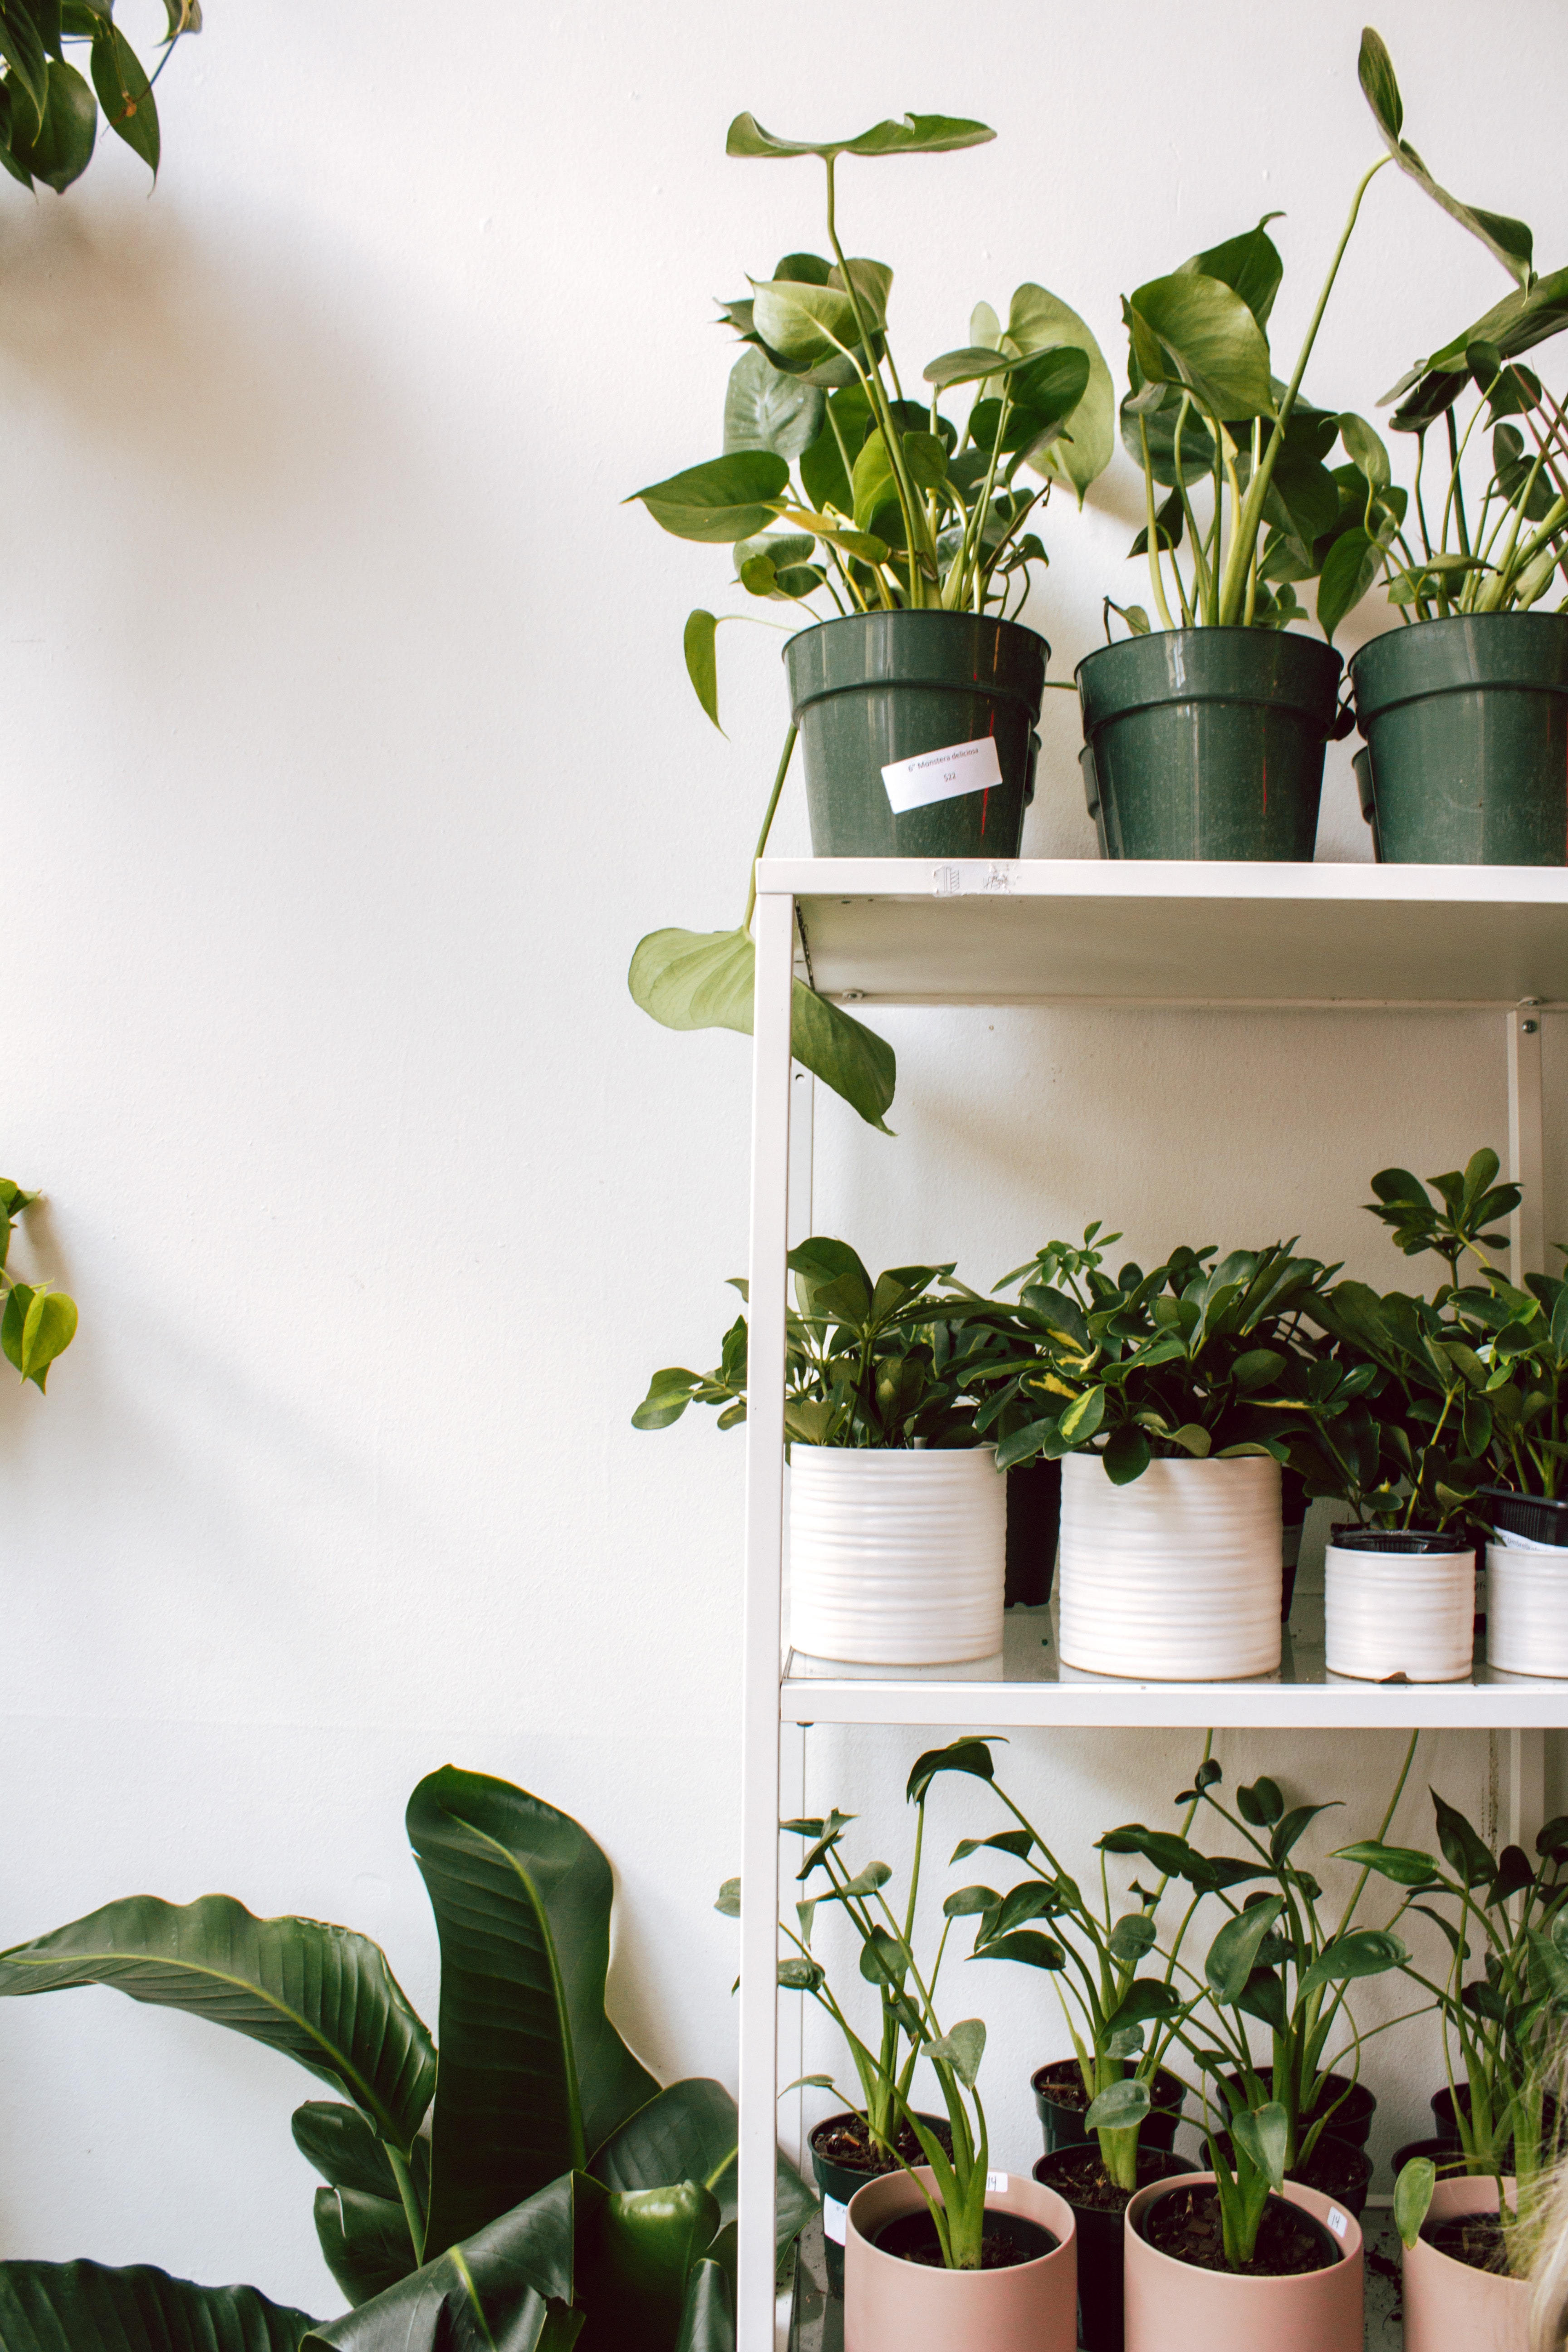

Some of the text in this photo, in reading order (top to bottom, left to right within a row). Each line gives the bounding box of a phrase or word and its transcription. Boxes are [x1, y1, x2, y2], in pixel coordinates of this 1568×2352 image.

[918, 755, 950, 769] Monstera
[952, 748, 979, 760] deliciosa
[944, 772, 956, 782] $22
[988, 2175, 997, 2191] 14
[1331, 2214, 1340, 2228] 14
